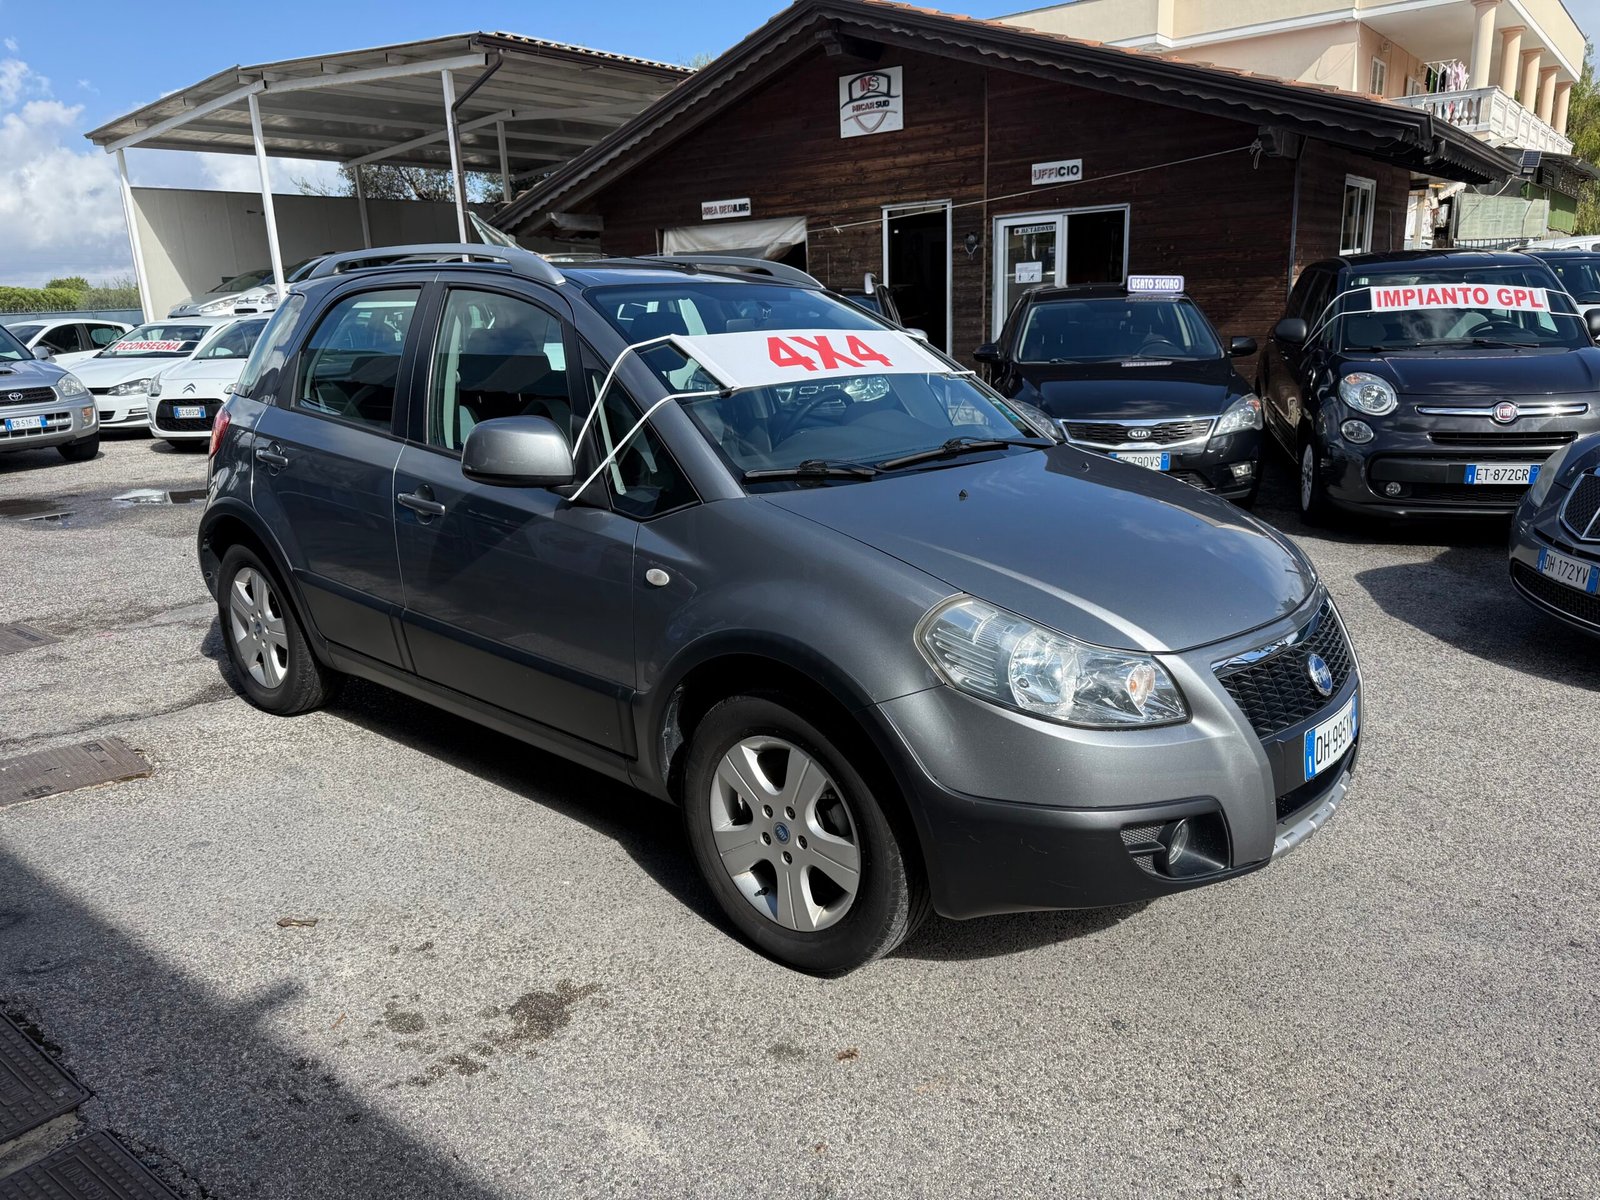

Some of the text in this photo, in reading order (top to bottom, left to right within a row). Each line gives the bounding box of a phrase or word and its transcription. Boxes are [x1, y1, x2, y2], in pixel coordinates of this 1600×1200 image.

[875, 100, 890, 109] SUD
[1033, 165, 1080, 180] UFFICIO
[1131, 278, 1180, 290] USATO SICURO
[1376, 287, 1544, 309] IMPIANTO GPL
[767, 335, 894, 371] 4X4
